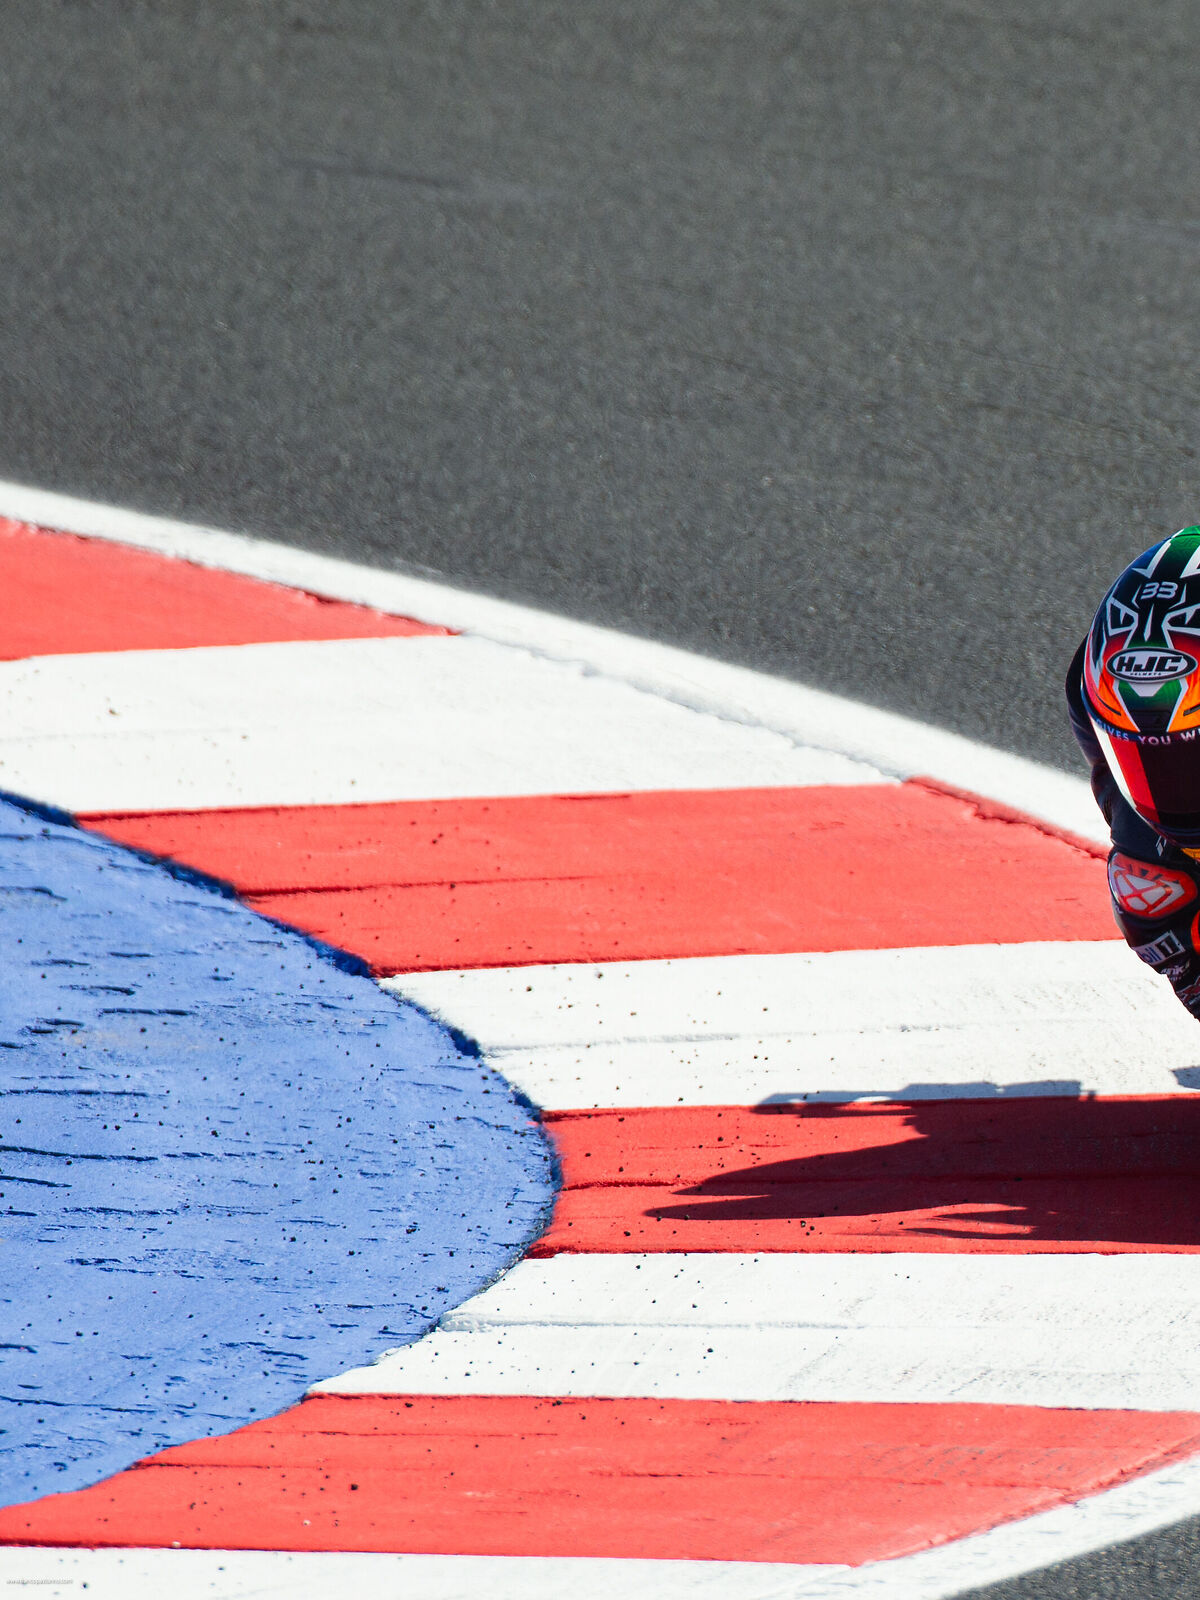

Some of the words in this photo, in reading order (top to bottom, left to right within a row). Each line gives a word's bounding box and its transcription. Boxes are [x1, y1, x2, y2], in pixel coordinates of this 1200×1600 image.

[1140, 582, 1178, 600] 33
[1115, 656, 1183, 672] HJC
[1138, 735, 1172, 745] YOU
